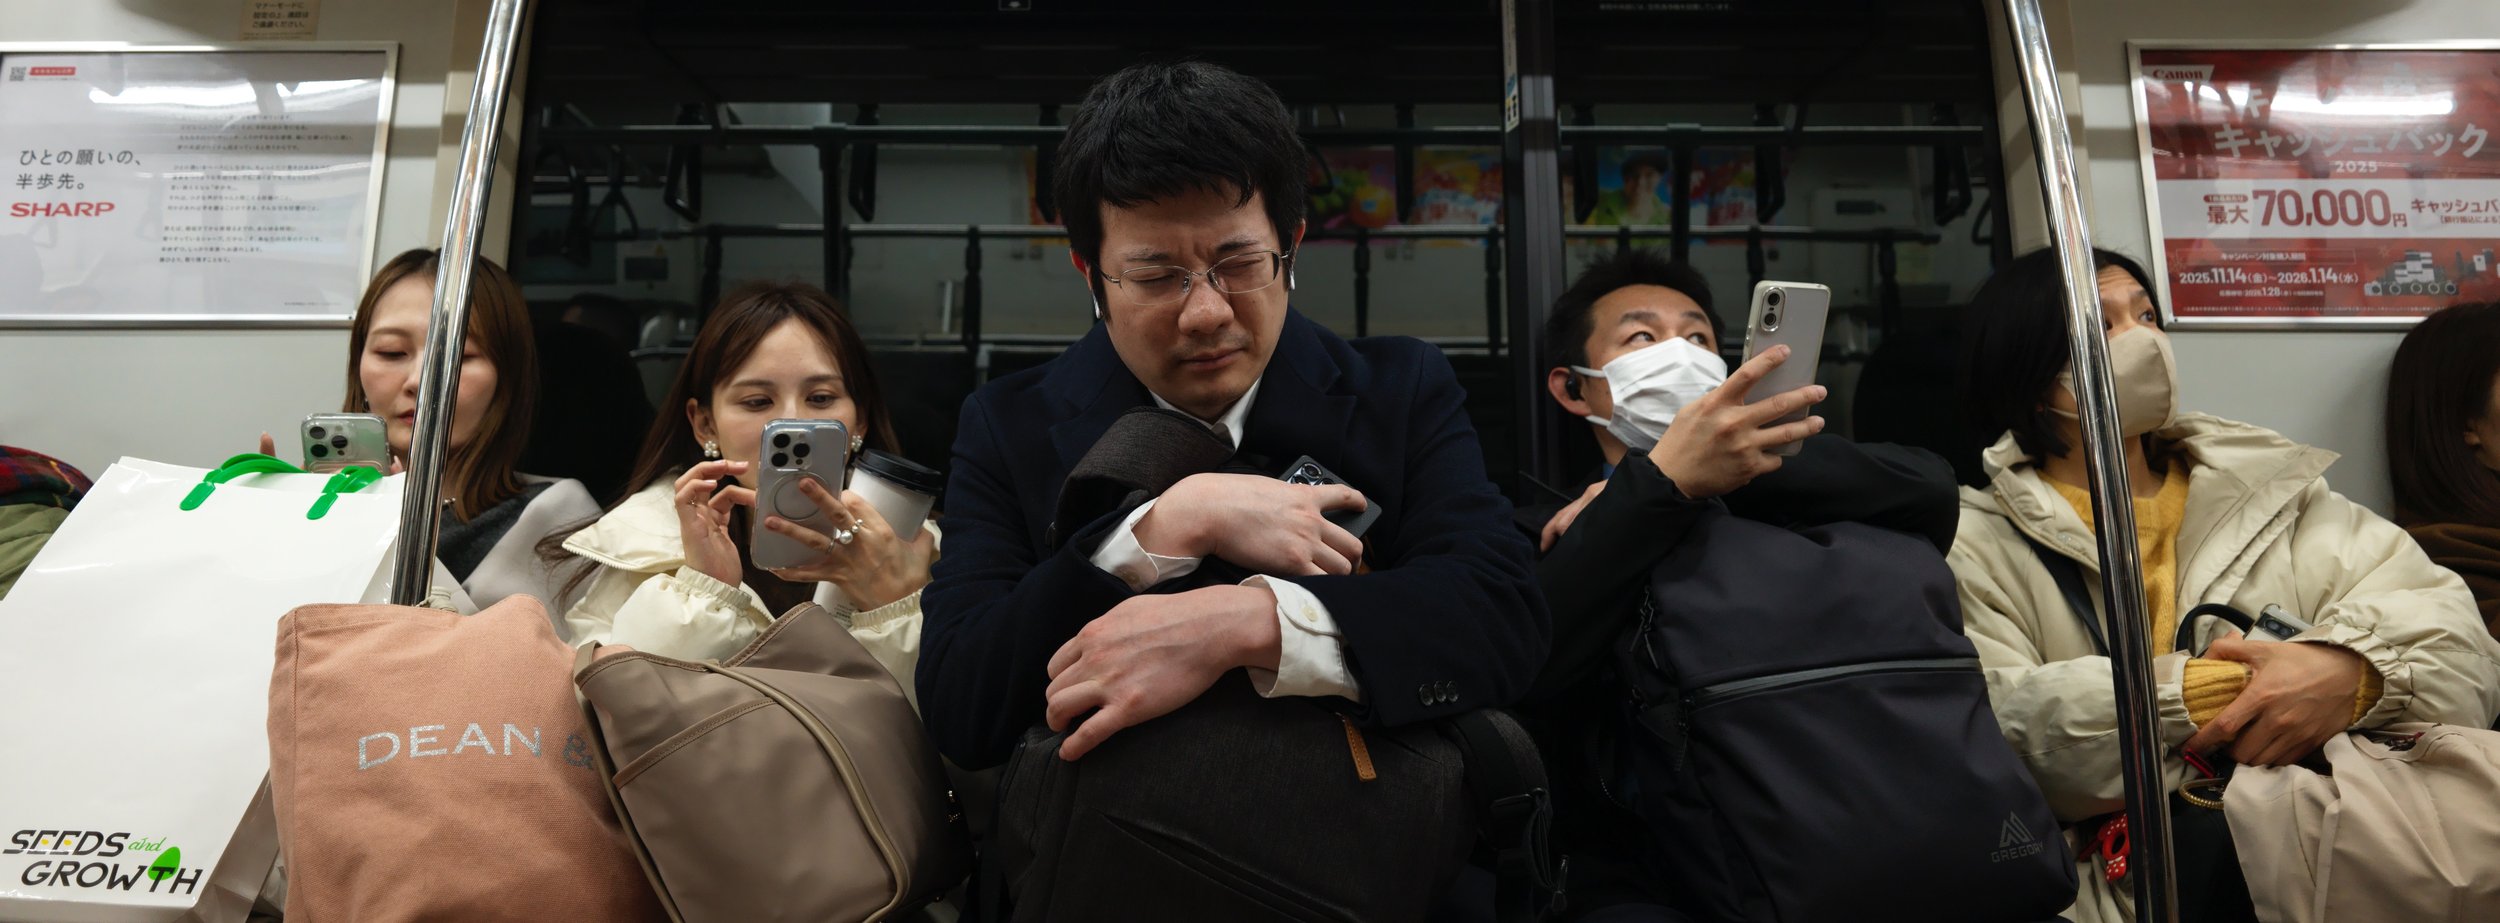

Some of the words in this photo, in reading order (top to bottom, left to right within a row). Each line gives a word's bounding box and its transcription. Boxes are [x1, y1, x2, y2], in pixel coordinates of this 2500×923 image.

[2152, 69, 2203, 79] Canon
[2214, 122, 2489, 158] キャッシュバック
[20, 149, 141, 166] ひとの願いの、
[2335, 160, 2378, 173] 2025
[16, 173, 85, 190] 半歩先。
[10, 202, 116, 217] SHARP
[358, 722, 542, 770] DEAN
[562, 730, 594, 770] &
[2, 829, 131, 858] SEEDS
[127, 836, 168, 852] and
[1991, 841, 2043, 863] GREGORY
[21, 860, 204, 895] GROWTH
